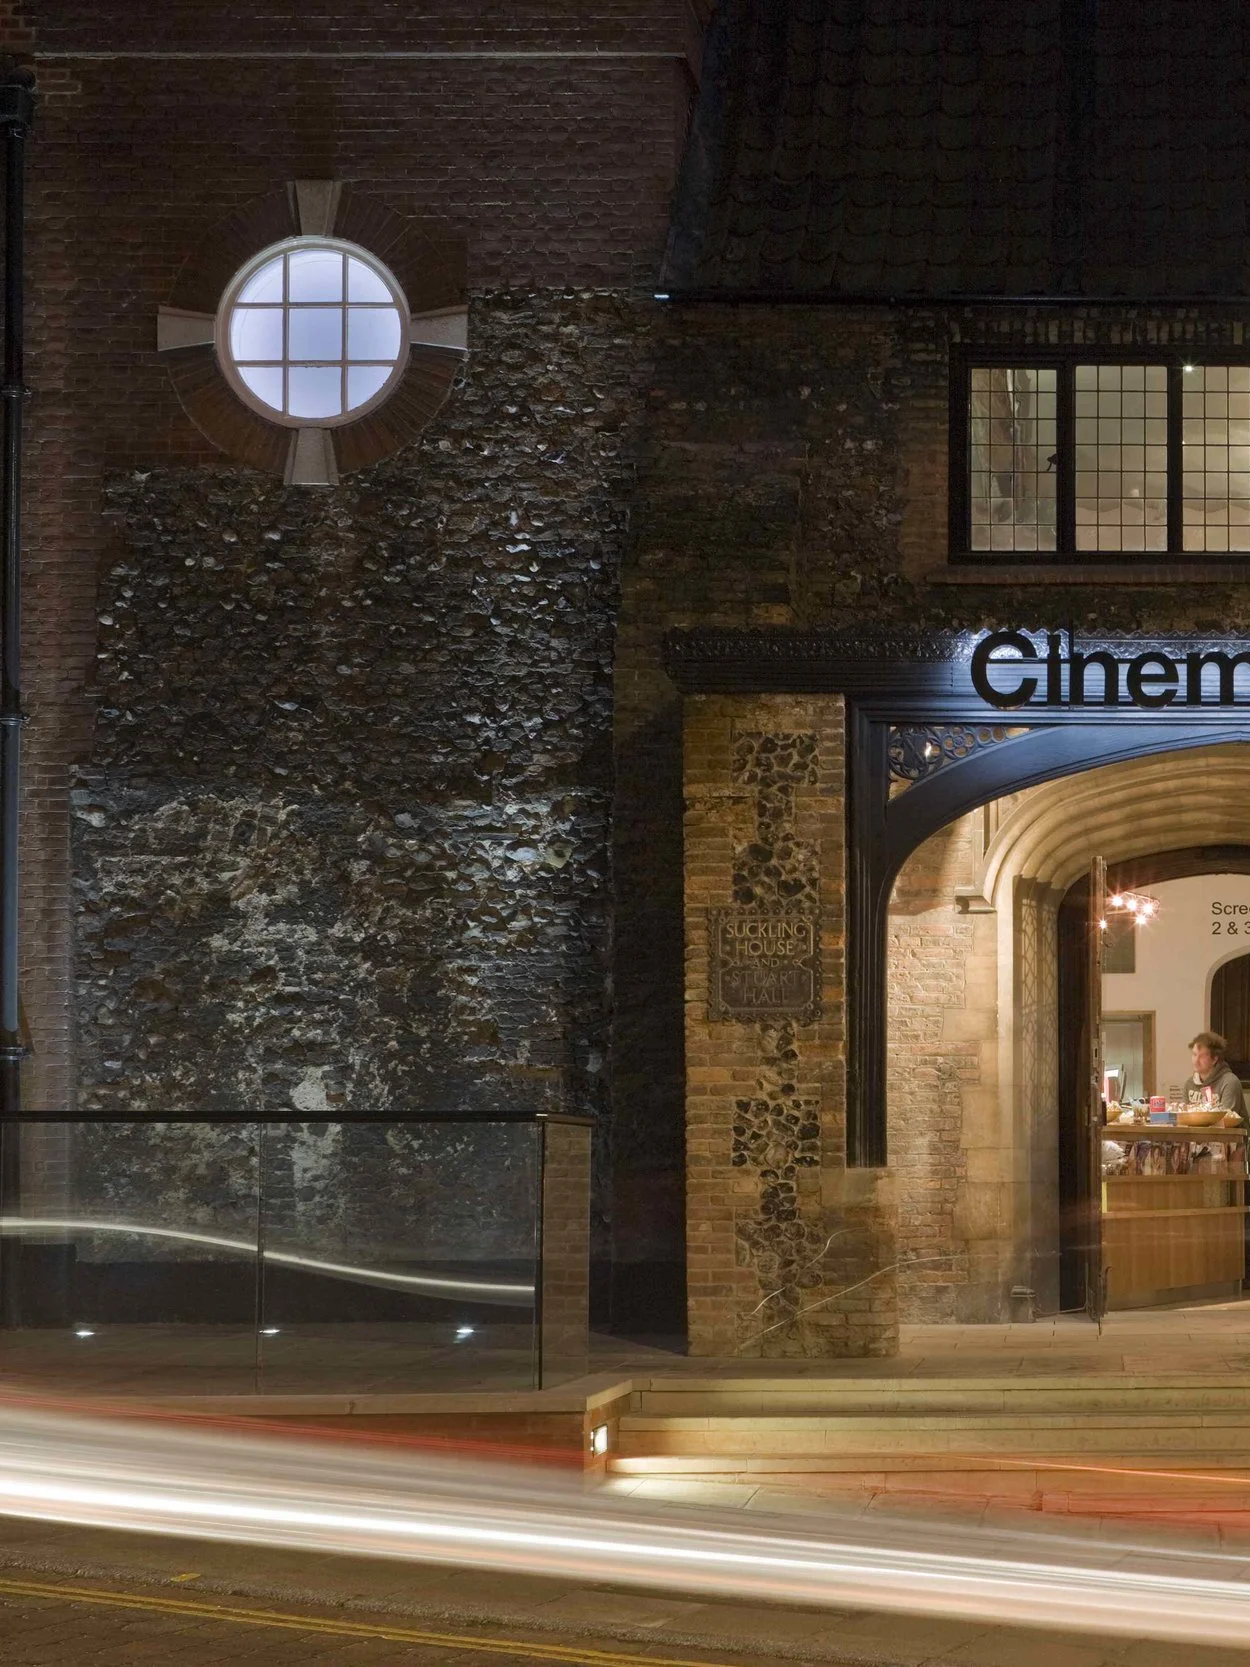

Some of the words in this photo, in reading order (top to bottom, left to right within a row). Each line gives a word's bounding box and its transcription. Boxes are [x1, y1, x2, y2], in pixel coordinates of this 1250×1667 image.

[725, 922, 806, 938] SUCKLING
[1211, 921, 1222, 935] 2
[1227, 921, 1239, 935] &
[735, 940, 797, 956] HOUSE
[752, 957, 781, 969] AND
[730, 970, 801, 987] STUART
[743, 988, 788, 1004] HALL
